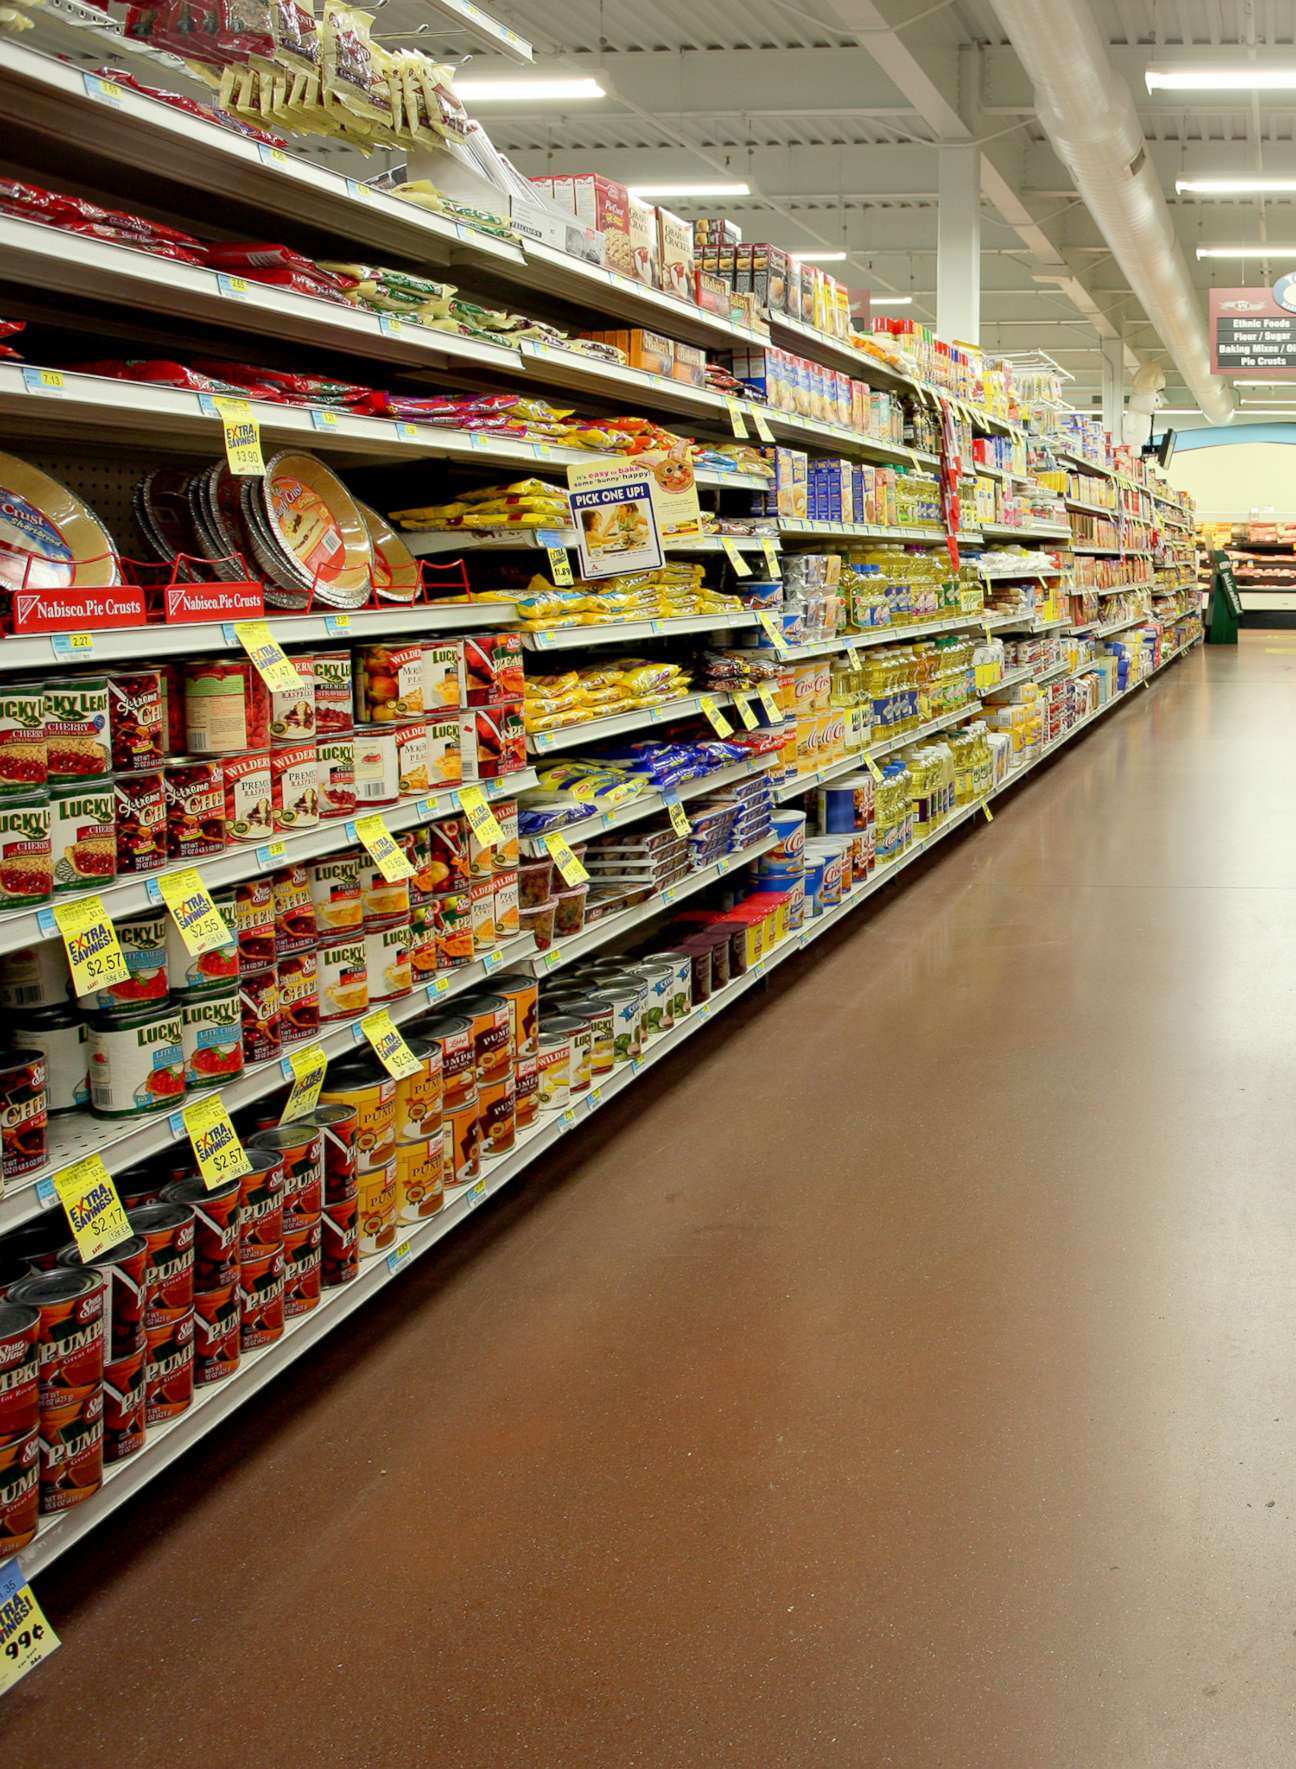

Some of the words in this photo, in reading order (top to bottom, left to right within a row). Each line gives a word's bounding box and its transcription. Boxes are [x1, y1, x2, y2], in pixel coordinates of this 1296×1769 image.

[1233, 319, 1262, 328] Ethnic
[1263, 319, 1290, 328] Foods
[1234, 332, 1257, 341] Flour
[1264, 331, 1291, 341] Sugar
[1219, 345, 1249, 354] Baking
[1252, 344, 1278, 353] Mixes
[1241, 357, 1257, 366] Pie
[1258, 357, 1286, 366] Crusts
[226, 423, 255, 438] EXTRA
[227, 431, 258, 448] SAVINGS!
[236, 451, 259, 463] $3.90
[588, 469, 609, 479] easy
[618, 465, 641, 475] bake
[576, 491, 601, 507] PICK
[602, 489, 625, 502] ONE
[626, 485, 645, 499] UP!
[37, 601, 84, 618] Nabisco
[86, 600, 104, 616] Pie
[106, 599, 141, 616] Crusts
[183, 596, 217, 611] Nabisco
[219, 595, 233, 610] Pie
[233, 593, 261, 608] Crusts
[48, 723, 89, 732] CHERRY
[60, 797, 111, 820] LUCKY
[173, 893, 205, 918] EXTRA
[179, 898, 213, 930] SAVINGS!
[68, 923, 109, 956] EXTRA
[190, 918, 220, 940] $2.55
[72, 928, 114, 966] SAVINGS!
[86, 952, 121, 977] $2.57
[183, 1000, 229, 1025] LUCKY
[137, 1020, 180, 1047] LUCKY
[194, 1123, 228, 1152] EXTRA
[200, 1128, 235, 1163] SAVINGS!
[214, 1148, 244, 1172] $2.57
[69, 1183, 108, 1221] EXTRA
[75, 1187, 115, 1232] SAVINGS!
[91, 1208, 123, 1236] $2.17
[5, 1623, 45, 1660] 99¢
